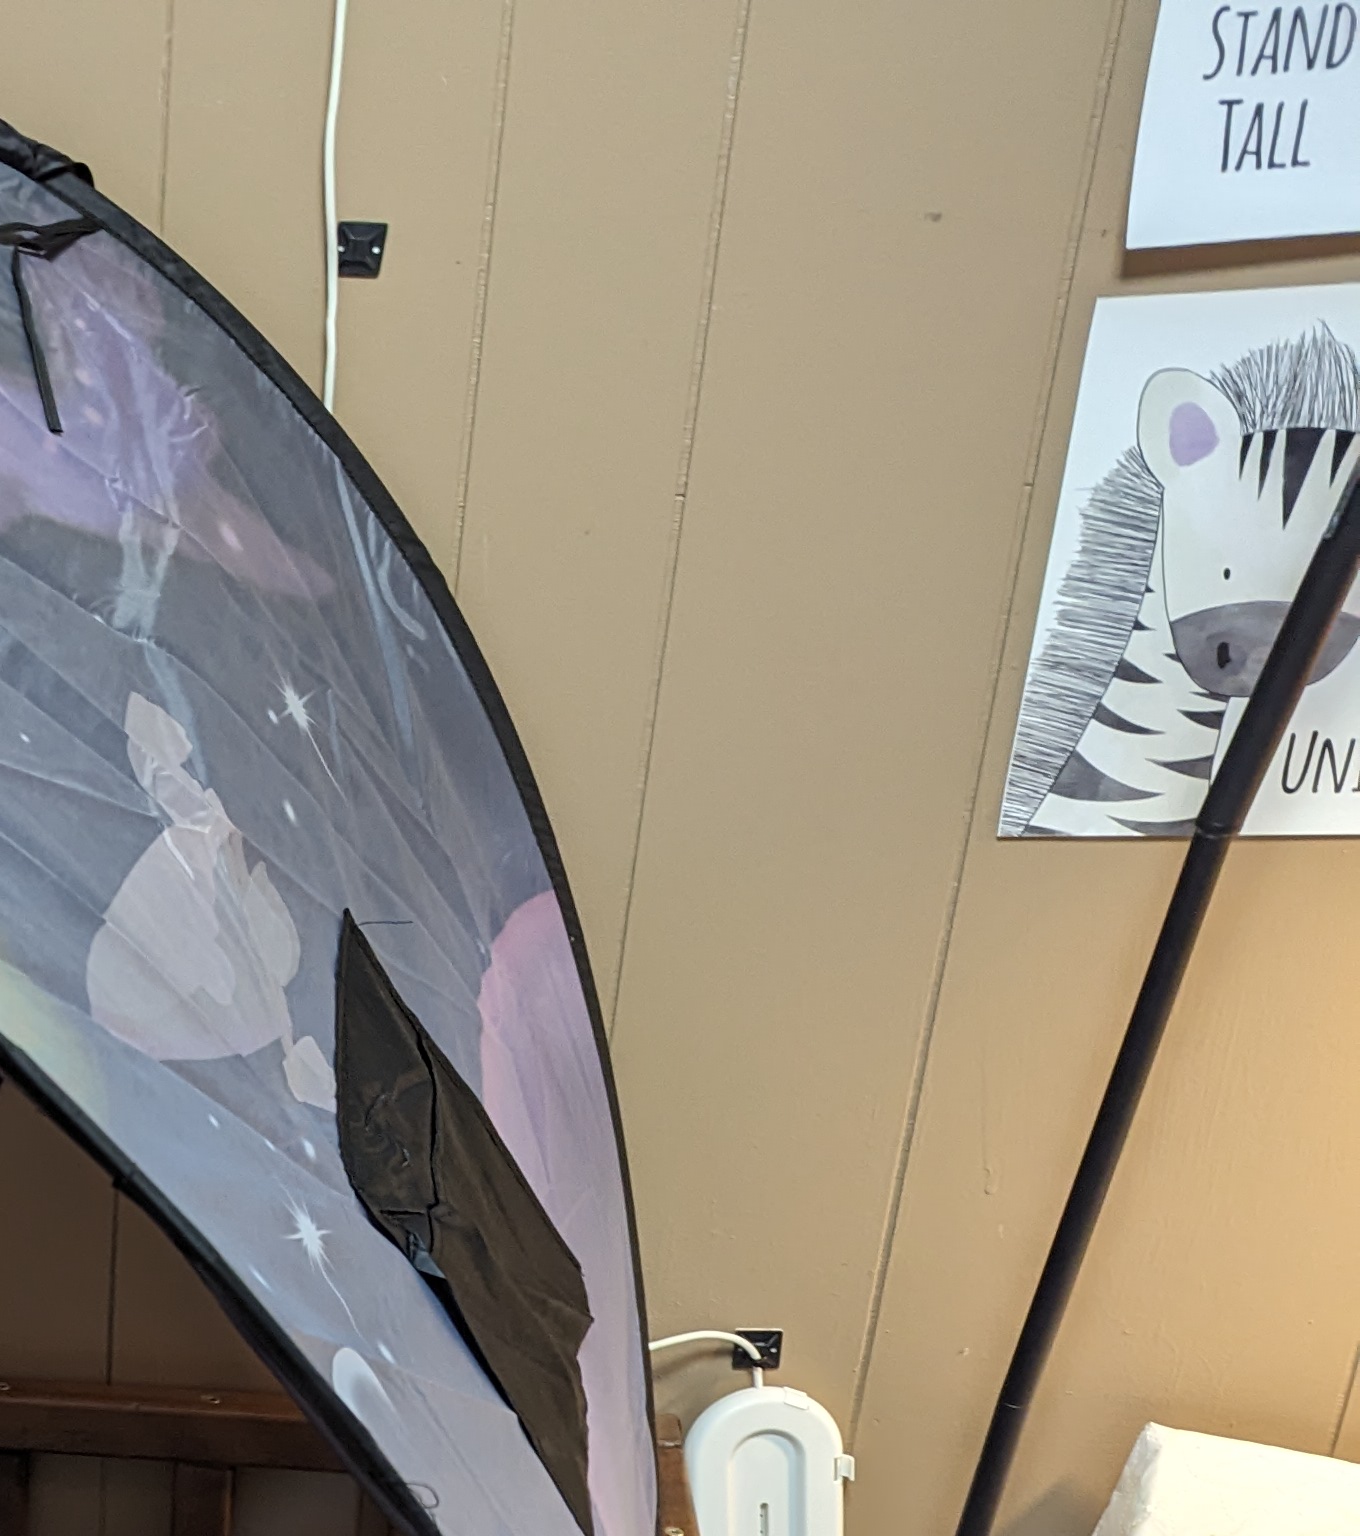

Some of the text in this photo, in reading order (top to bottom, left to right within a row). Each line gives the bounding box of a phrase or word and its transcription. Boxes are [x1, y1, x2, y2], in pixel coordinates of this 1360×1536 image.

[1202, 3, 1357, 80] STAND
[1218, 98, 1310, 173] TALL
[1281, 730, 1360, 794] UN
